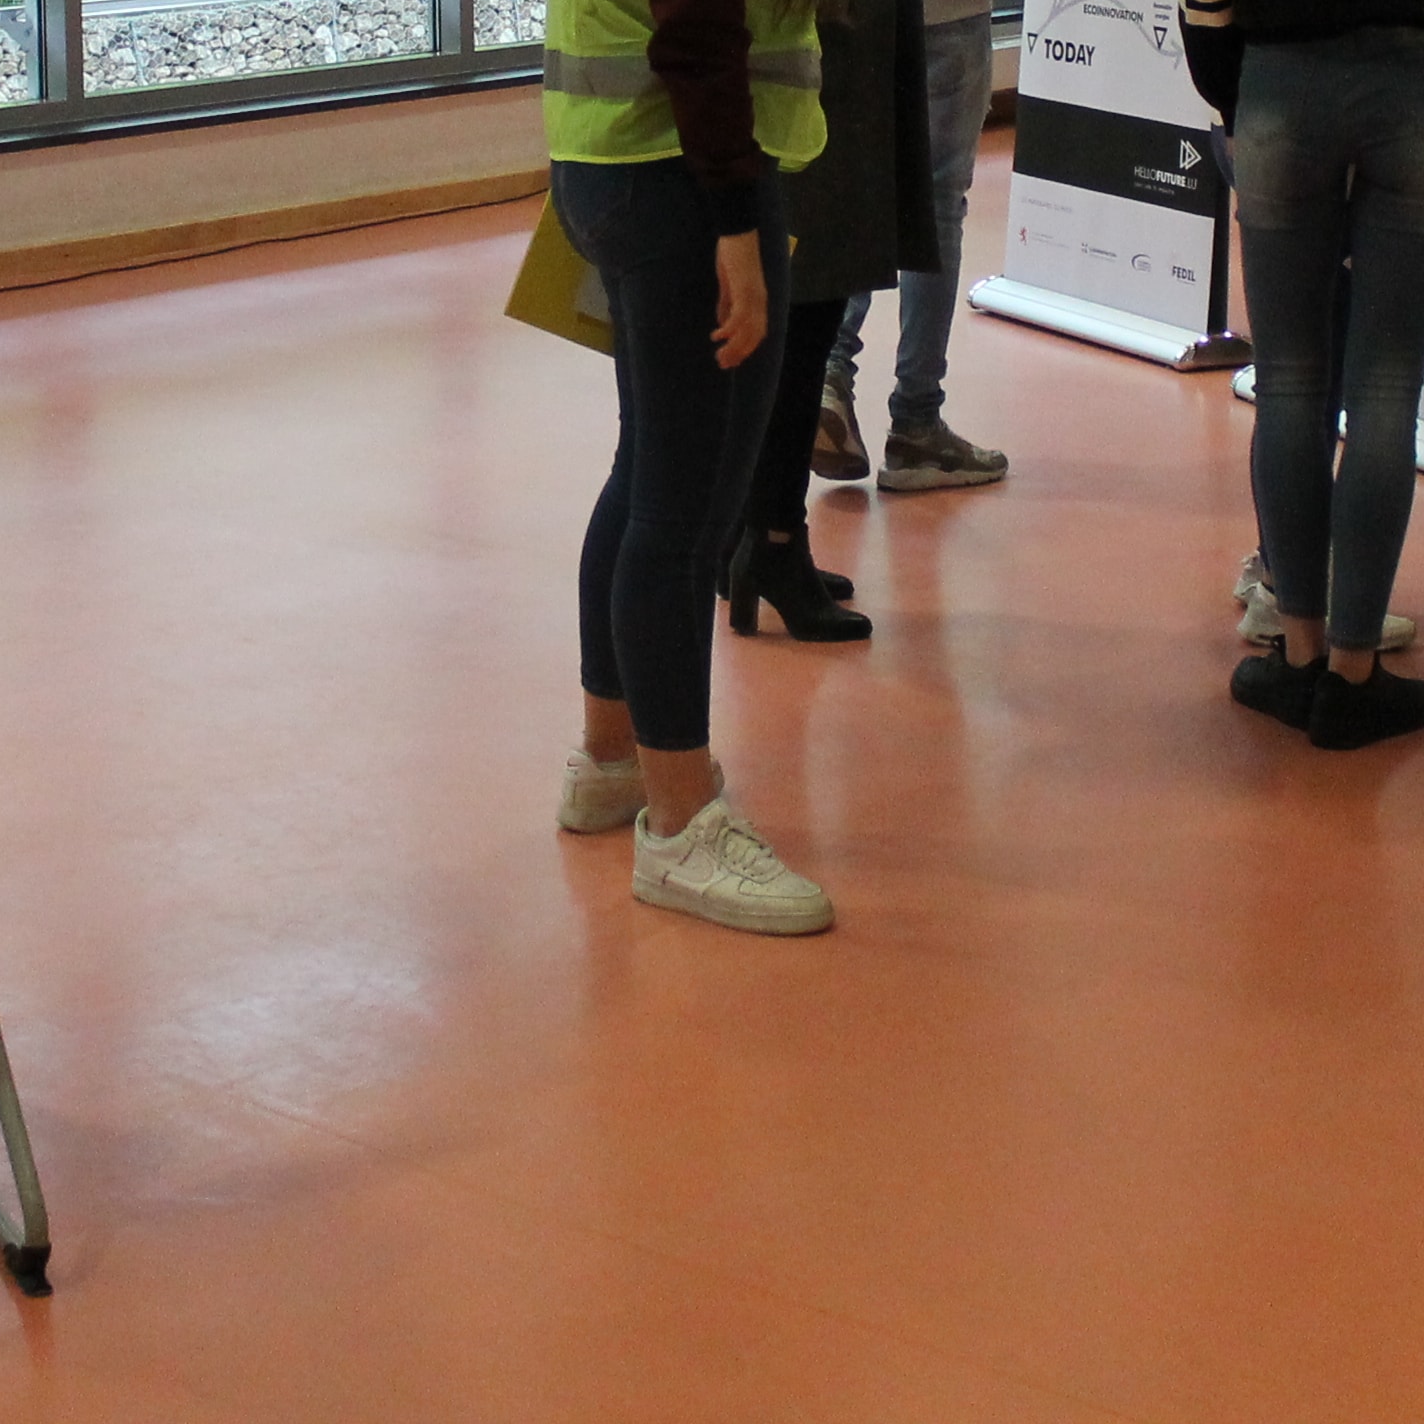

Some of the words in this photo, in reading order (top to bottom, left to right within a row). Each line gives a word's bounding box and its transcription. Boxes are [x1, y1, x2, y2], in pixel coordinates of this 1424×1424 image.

[1083, 4, 1144, 23] ECOINNOVATION
[1044, 38, 1095, 67] TODAY
[1172, 266, 1196, 282] FEDIL
